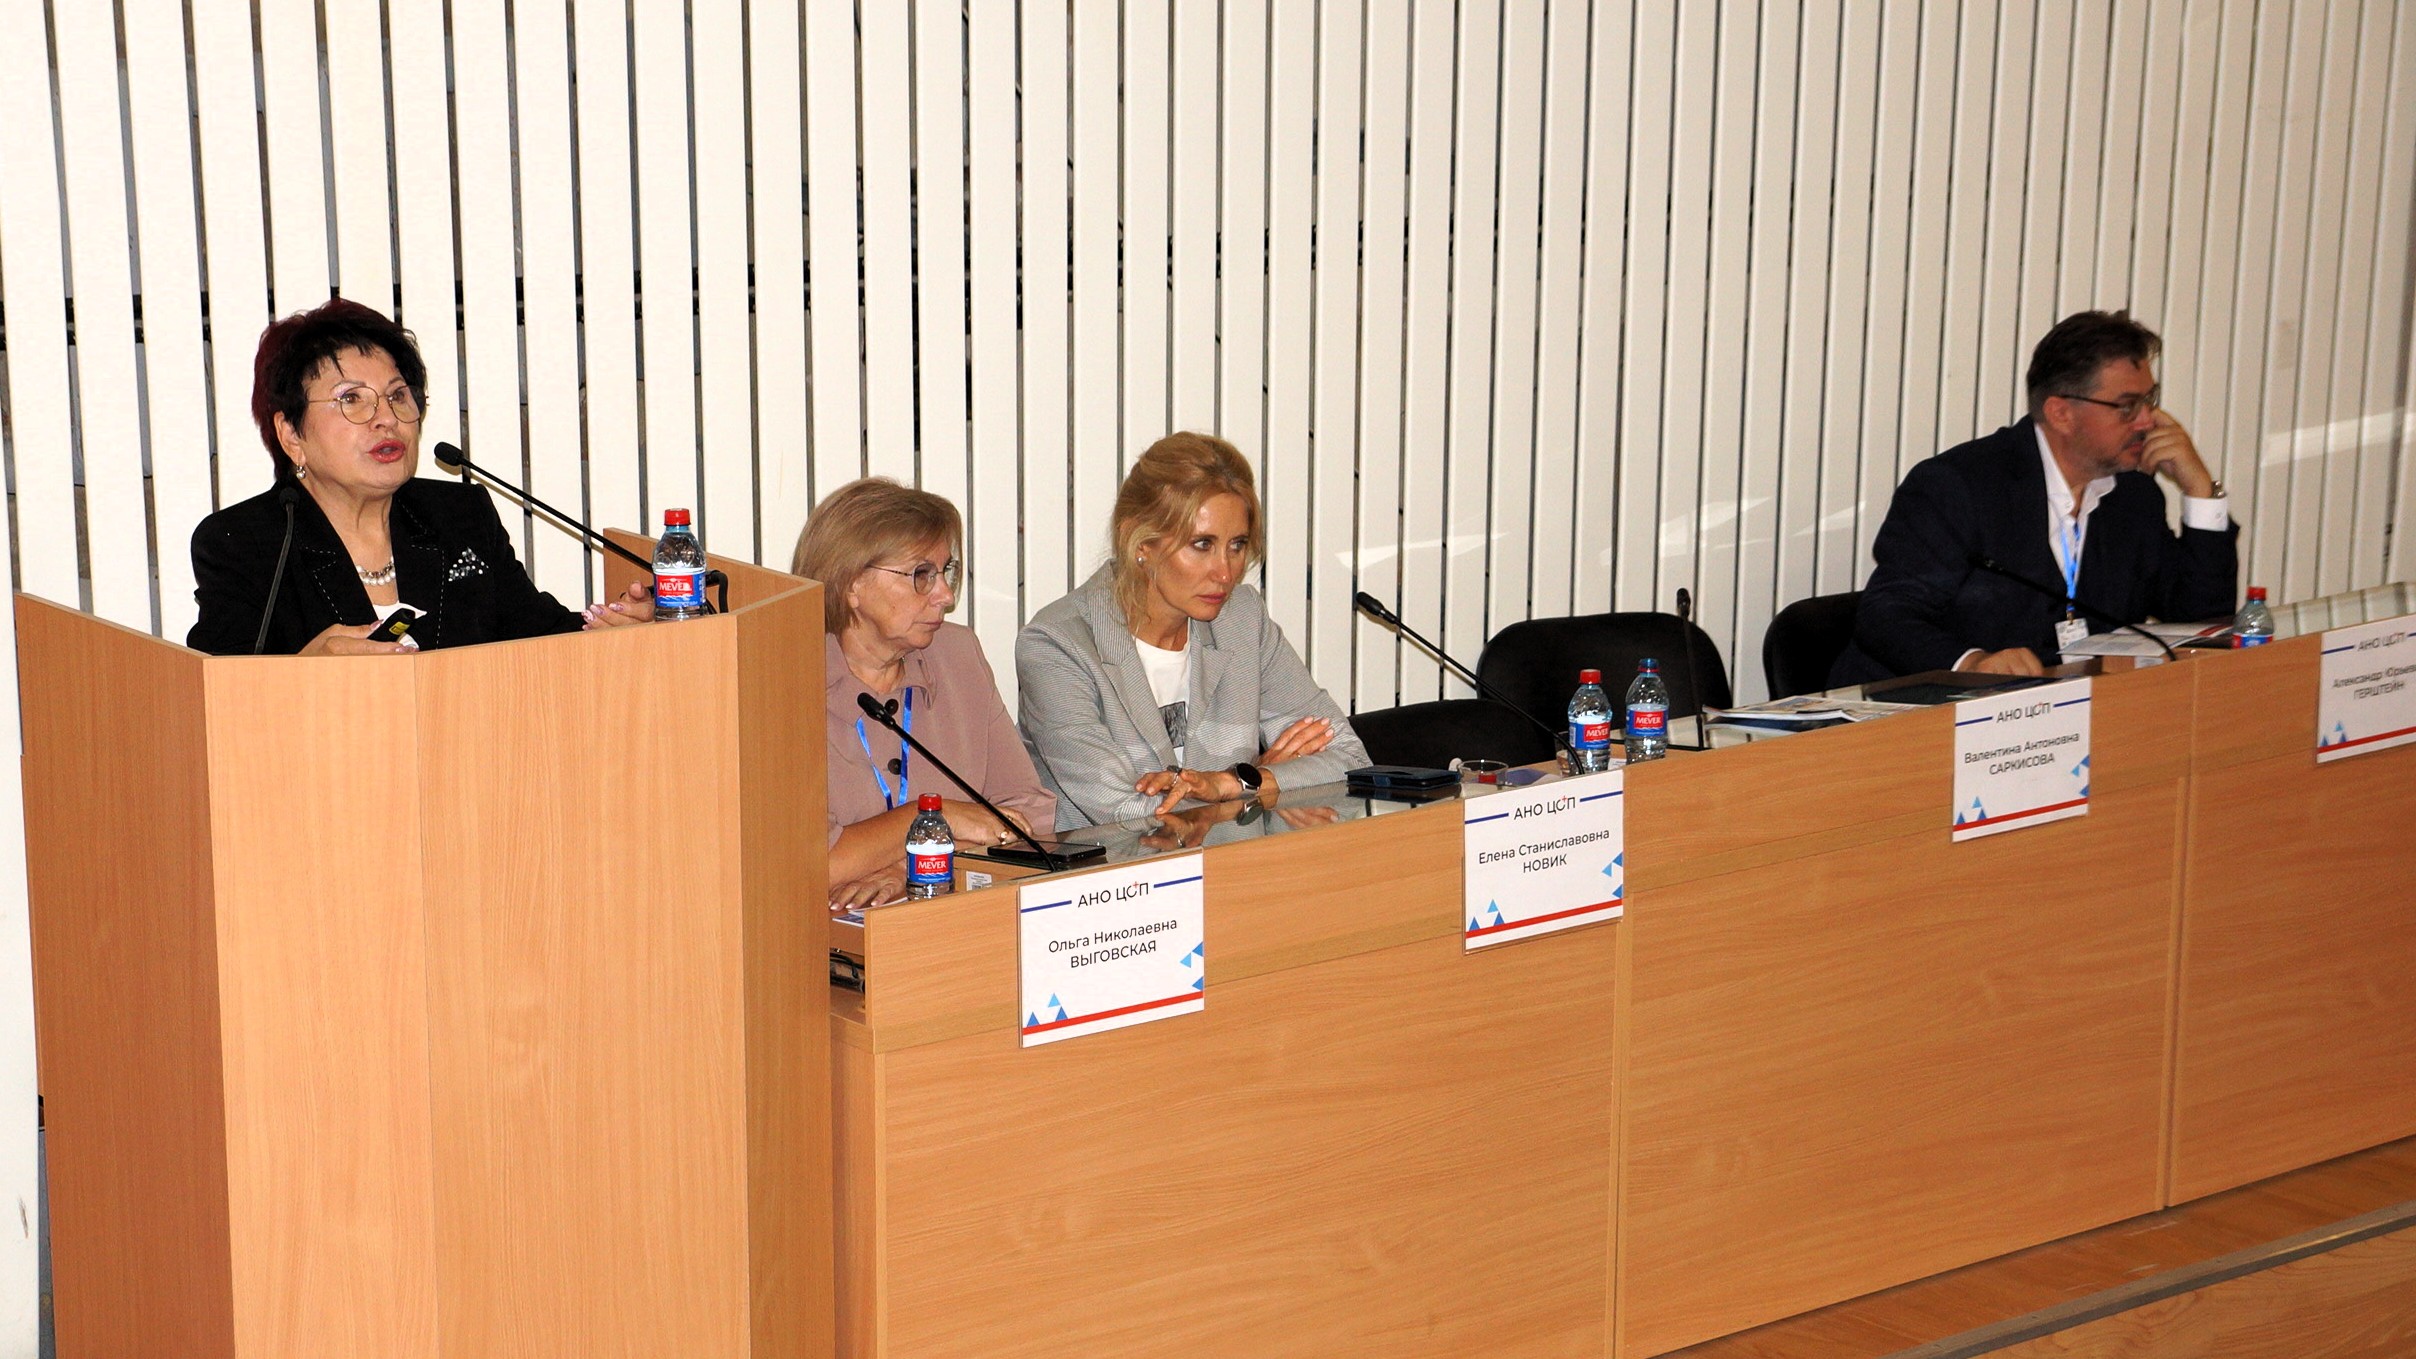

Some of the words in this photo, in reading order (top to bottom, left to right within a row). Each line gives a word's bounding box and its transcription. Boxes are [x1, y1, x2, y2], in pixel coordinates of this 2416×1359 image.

[1996, 708, 2021, 723] АНО
[2025, 702, 2050, 718] ЦСП
[1964, 744, 2021, 764] Валентина
[2023, 733, 2080, 751] Антоновна
[1989, 753, 2055, 775] САРКИСОВА
[1513, 803, 1543, 820] АНО
[1547, 796, 1576, 814] ЦСП
[1478, 848, 1516, 864] Елена
[1519, 829, 1610, 856] Станиславовна
[918, 861, 946, 869] MEVER
[1523, 854, 1567, 873] НОВИК
[1077, 890, 1111, 908] АНО
[1116, 882, 1149, 902] ЦСП
[1048, 936, 1090, 953] Ольга
[1094, 919, 1178, 943] Николаевна
[1070, 940, 1157, 968] ВЫГОВСКАЯ
